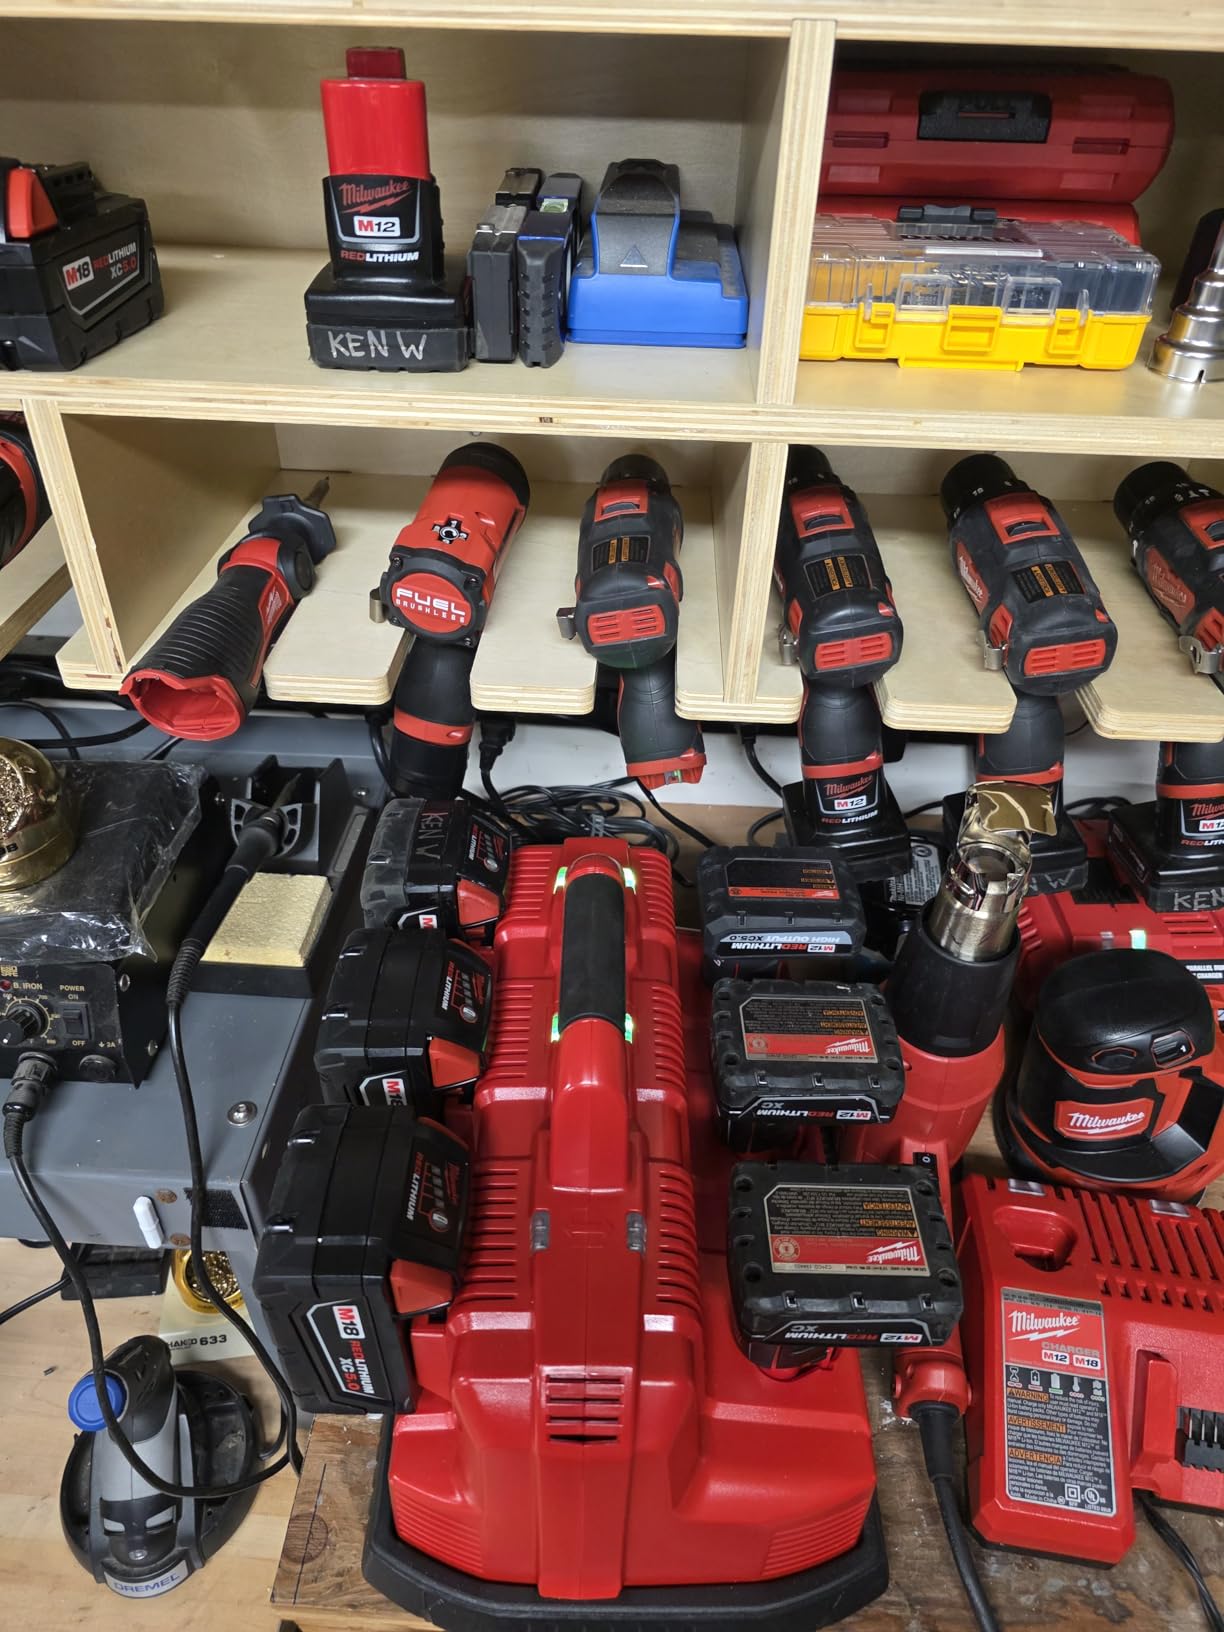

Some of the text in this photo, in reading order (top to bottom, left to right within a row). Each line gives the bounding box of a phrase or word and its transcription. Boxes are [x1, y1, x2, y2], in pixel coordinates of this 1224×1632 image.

[339, 181, 409, 206] Milwaukee
[357, 220, 396, 233] M12
[340, 250, 419, 262] REDLITHIUM
[65, 261, 91, 287] M18
[328, 331, 427, 360] KEN W
[396, 588, 466, 615] FUEL
[396, 599, 465, 624] BRUSHLESS
[824, 774, 874, 796] Milwaukee
[836, 799, 865, 808] M12
[821, 810, 879, 824] REDLITHIUM
[731, 942, 808, 950] REDLITHIUM
[23, 982, 43, 990] IRON
[824, 1040, 871, 1055] Milwaukee
[756, 1109, 870, 1119] M12 REDLITHIUM
[1067, 1111, 1145, 1127] Milwaukee
[406, 1151, 425, 1221] REDLITHIUM
[866, 1245, 921, 1264] Milwaukee
[337, 1307, 359, 1338] M18
[1008, 1310, 1080, 1333] Milwaukee
[200, 1334, 227, 1346] 633
[785, 1332, 920, 1342] M12 REDLITHIUM
[1041, 1341, 1100, 1358] CHARGER
[350, 1340, 375, 1394] REDLITHIUM
[1043, 1352, 1068, 1362] M12
[1075, 1356, 1099, 1368] M18
[339, 1357, 361, 1392] XC5.0
[1015, 1389, 1049, 1402] WARNING
[1009, 1416, 1065, 1432] AVERTISSEMENT
[1009, 1448, 1061, 1465] ADVERTENCIA
[114, 1573, 180, 1592] DREMEL
